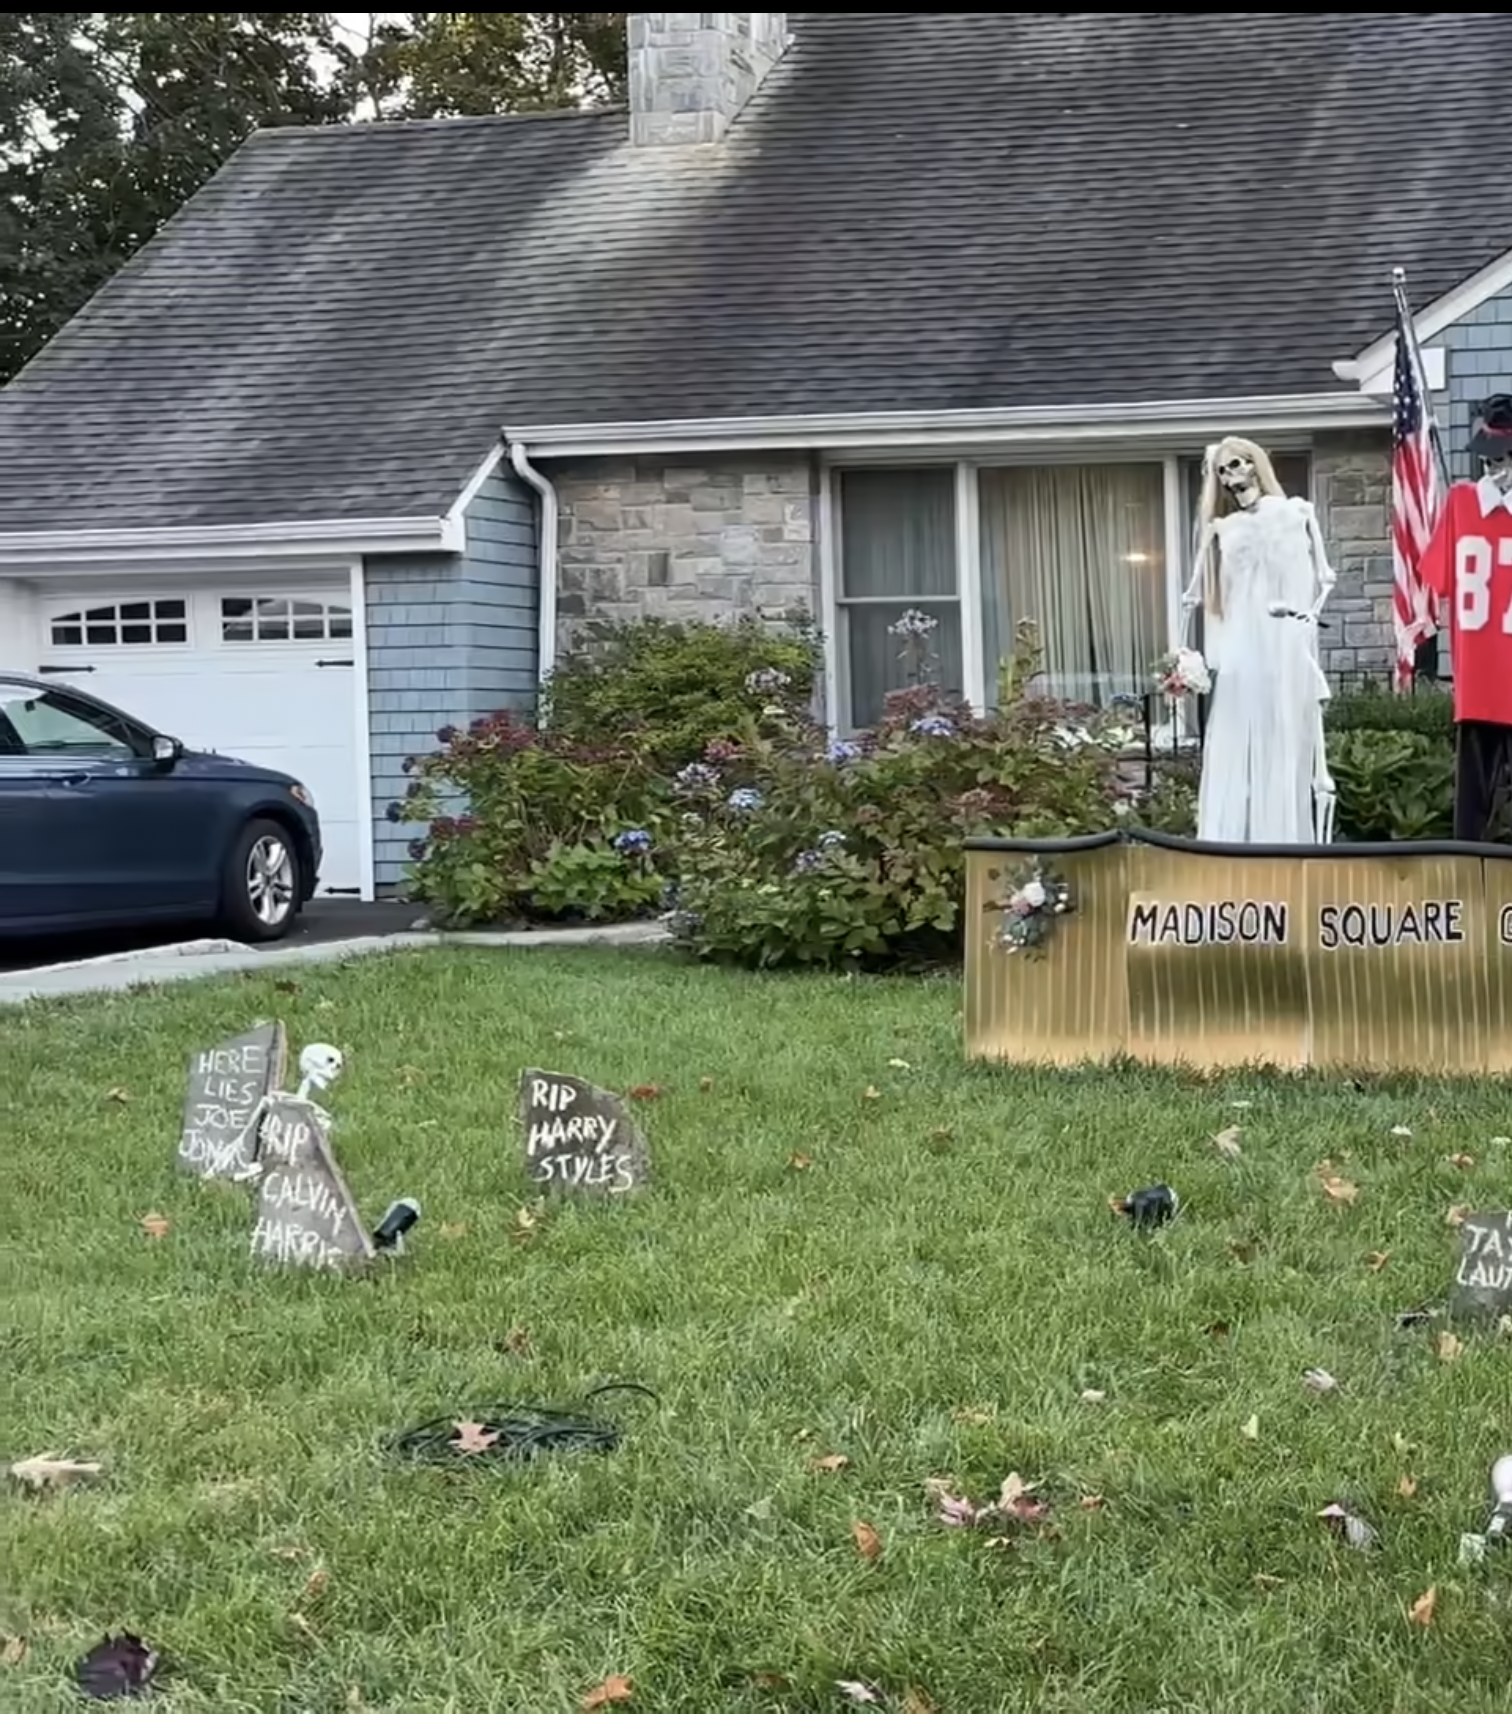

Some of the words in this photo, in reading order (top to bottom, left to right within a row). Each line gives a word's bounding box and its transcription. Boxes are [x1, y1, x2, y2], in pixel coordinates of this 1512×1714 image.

[1129, 900, 1289, 945] MADISON
[1319, 900, 1464, 948] SQUARE
[199, 1045, 263, 1075] HERE
[204, 1076, 257, 1106] LIES
[532, 1079, 577, 1112] RIP
[194, 1103, 247, 1129] JOE
[527, 1115, 617, 1156] HARRY
[262, 1113, 311, 1167] RIP
[531, 1153, 633, 1193] STYLES
[262, 1172, 347, 1236] CALVIN
